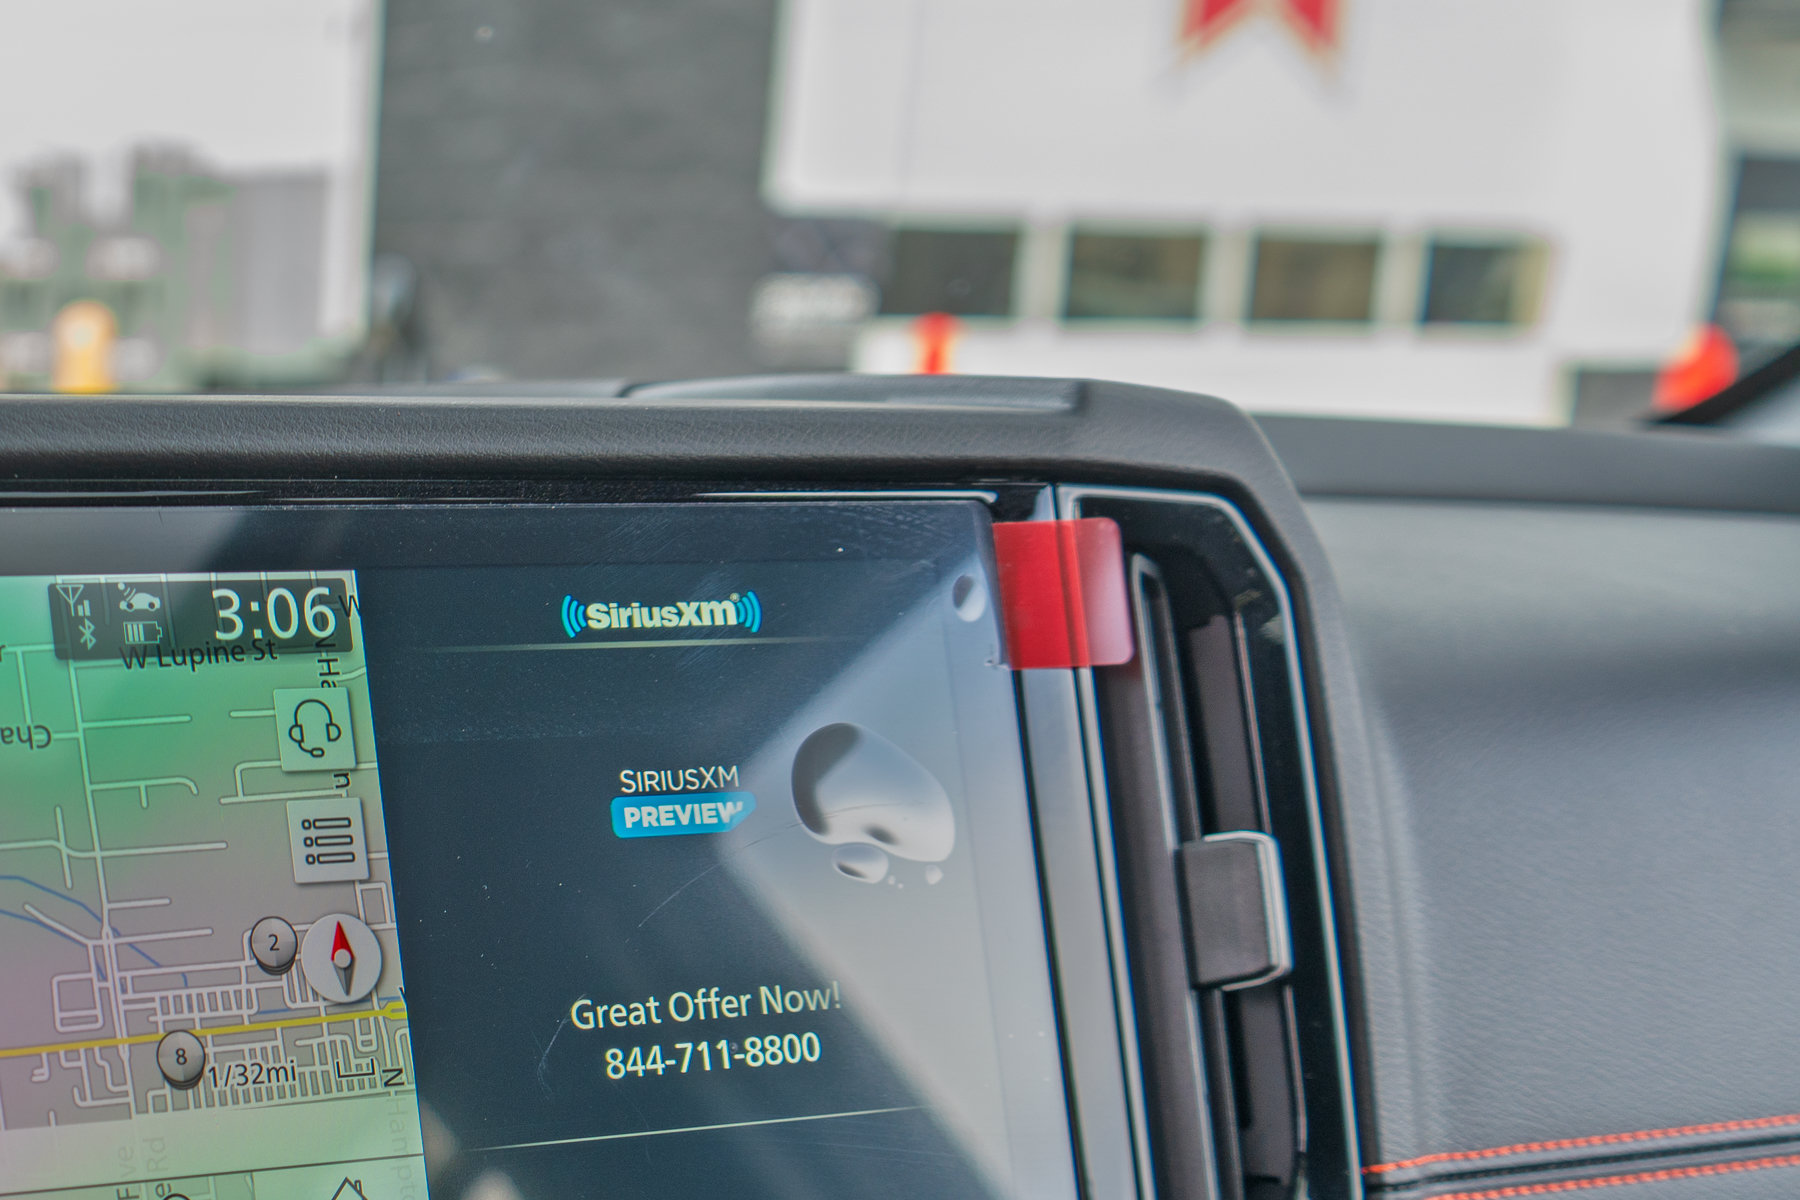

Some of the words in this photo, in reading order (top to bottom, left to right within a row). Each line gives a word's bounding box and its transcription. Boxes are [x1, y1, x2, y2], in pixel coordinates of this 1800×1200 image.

[212, 588, 336, 640] 3:06
[119, 647, 149, 669] W
[157, 642, 244, 671] Lupine
[252, 637, 278, 660] St
[619, 765, 740, 793] SIRIUSXM
[623, 801, 744, 828] PREVIEW
[268, 934, 280, 951] 2
[570, 993, 662, 1031] Great
[667, 986, 752, 1024] Offer
[759, 981, 842, 1014] Now!
[175, 1047, 187, 1066] 8
[605, 1031, 822, 1080] 844-711-8800
[208, 1060, 297, 1089] 1/32mi
